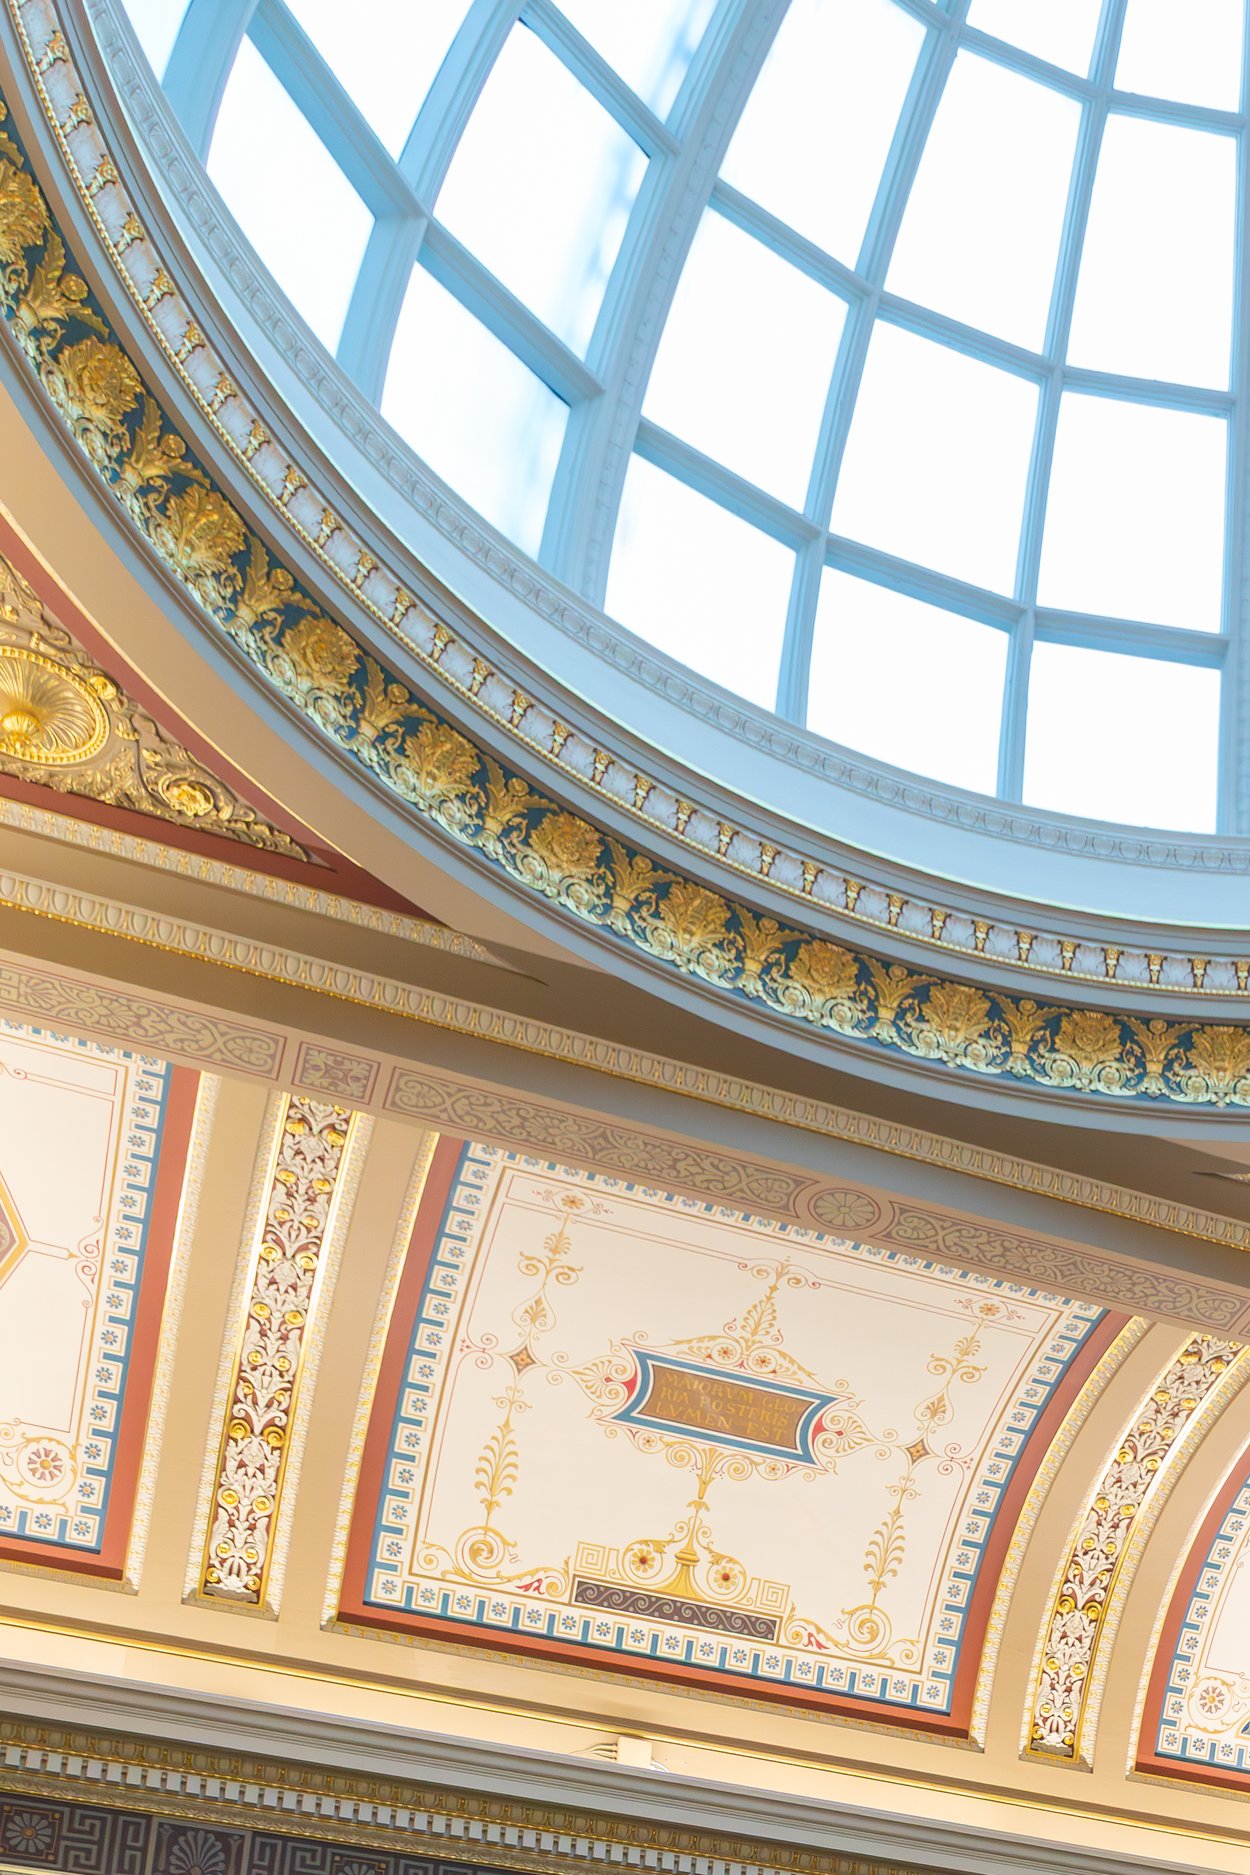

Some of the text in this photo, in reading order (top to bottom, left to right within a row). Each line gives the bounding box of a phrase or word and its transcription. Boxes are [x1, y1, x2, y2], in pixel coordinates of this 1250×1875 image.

[660, 1387, 790, 1426] RIA POSTERIS
[661, 1371, 753, 1404] MAIORVM
[656, 1402, 787, 1441] LVMEN EST
